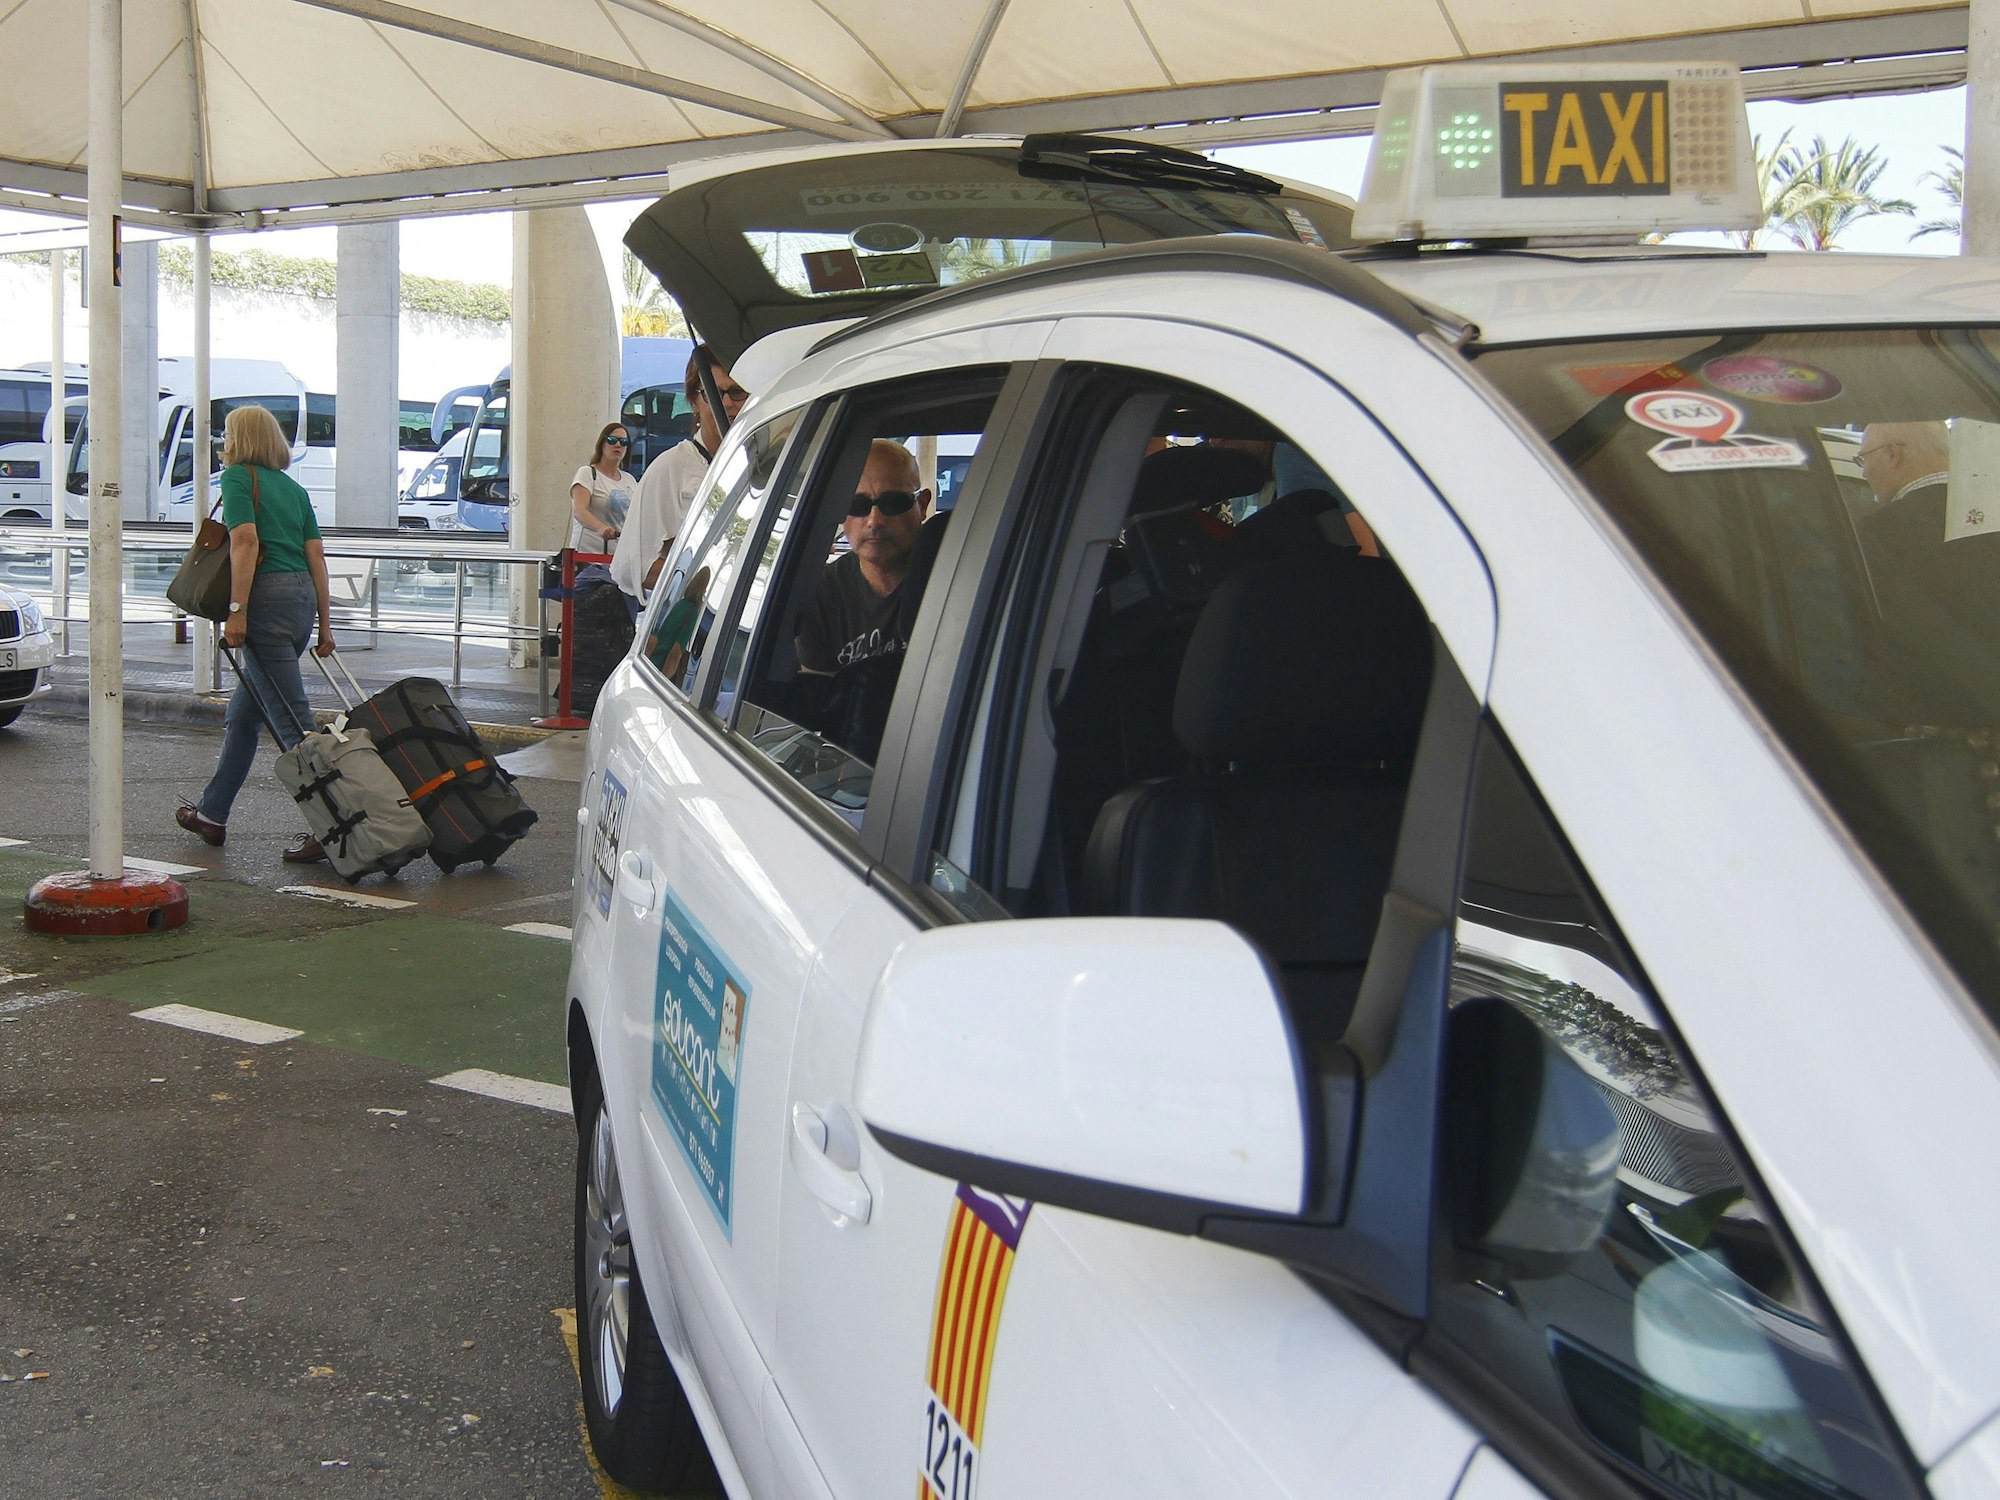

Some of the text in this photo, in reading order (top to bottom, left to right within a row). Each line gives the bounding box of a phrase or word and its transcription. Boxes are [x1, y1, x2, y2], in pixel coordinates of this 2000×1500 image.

[1504, 91, 1666, 186] TAXI
[806, 191, 891, 207] 900
[906, 188, 989, 202] 200
[867, 256, 926, 274] V2
[1651, 405, 1719, 420] TAXI
[926, 1399, 973, 1500] 1211
